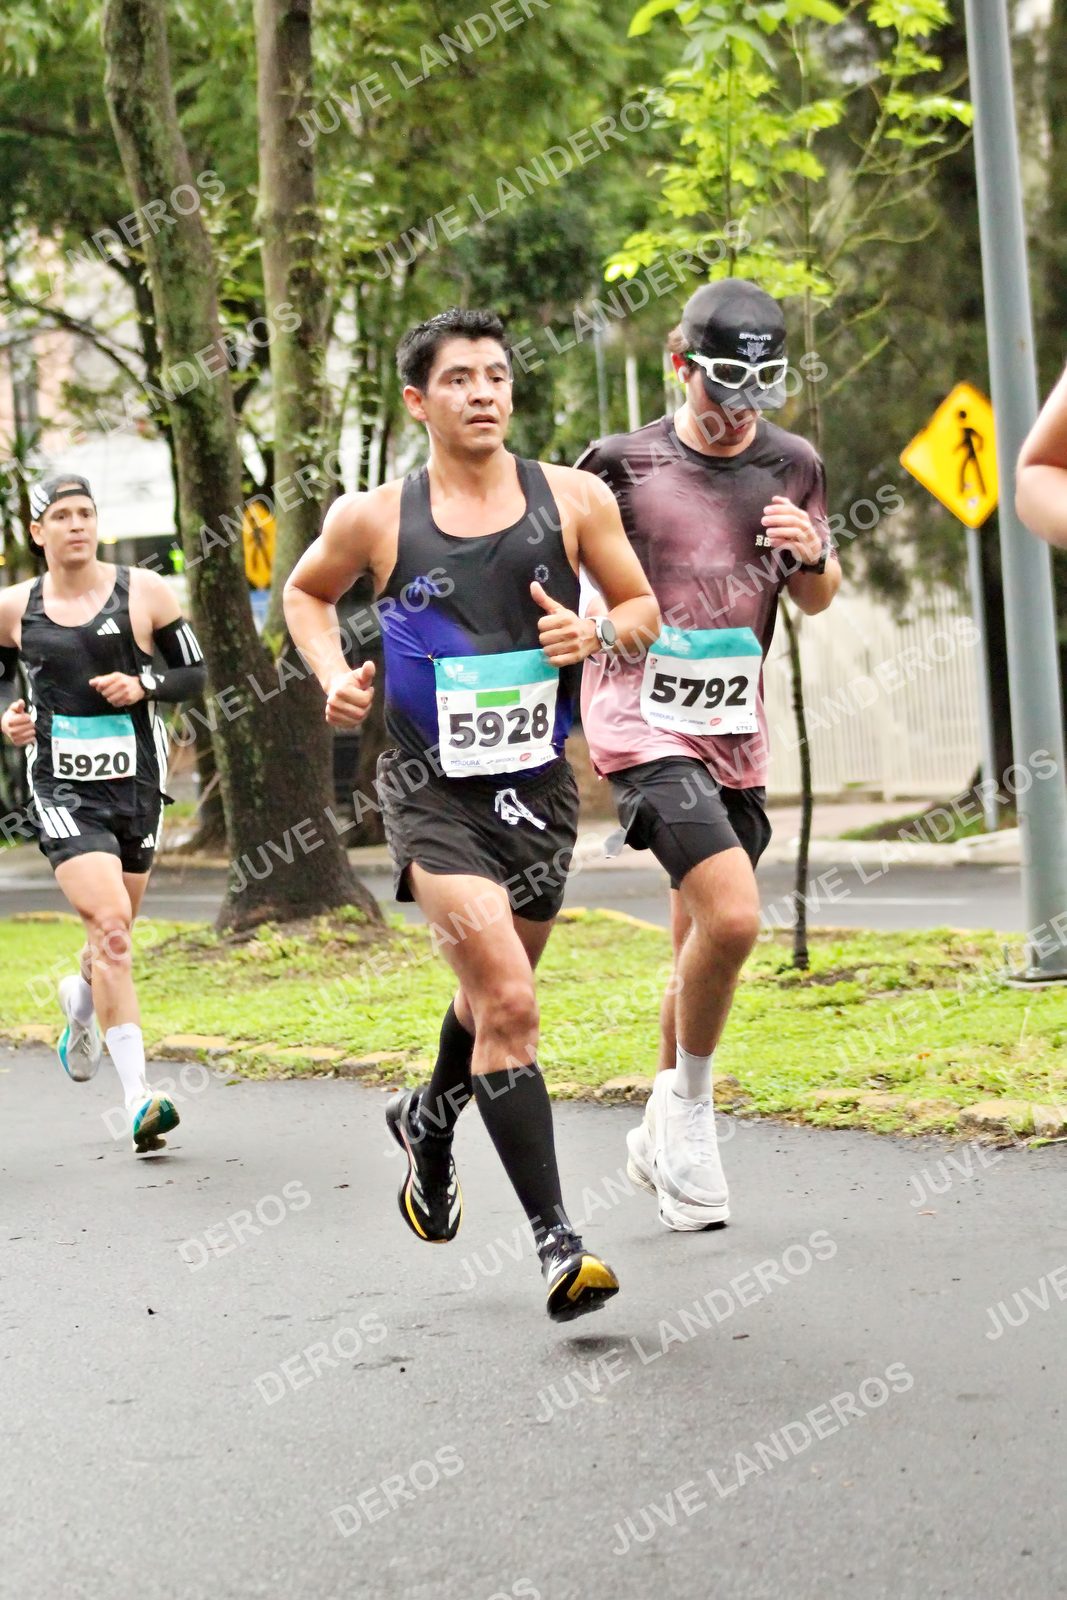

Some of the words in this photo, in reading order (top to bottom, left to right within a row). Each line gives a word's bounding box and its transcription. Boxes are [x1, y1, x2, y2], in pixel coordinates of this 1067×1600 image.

[649, 672, 749, 709] 5792
[448, 702, 549, 749] 5928
[58, 751, 130, 777] 5920
